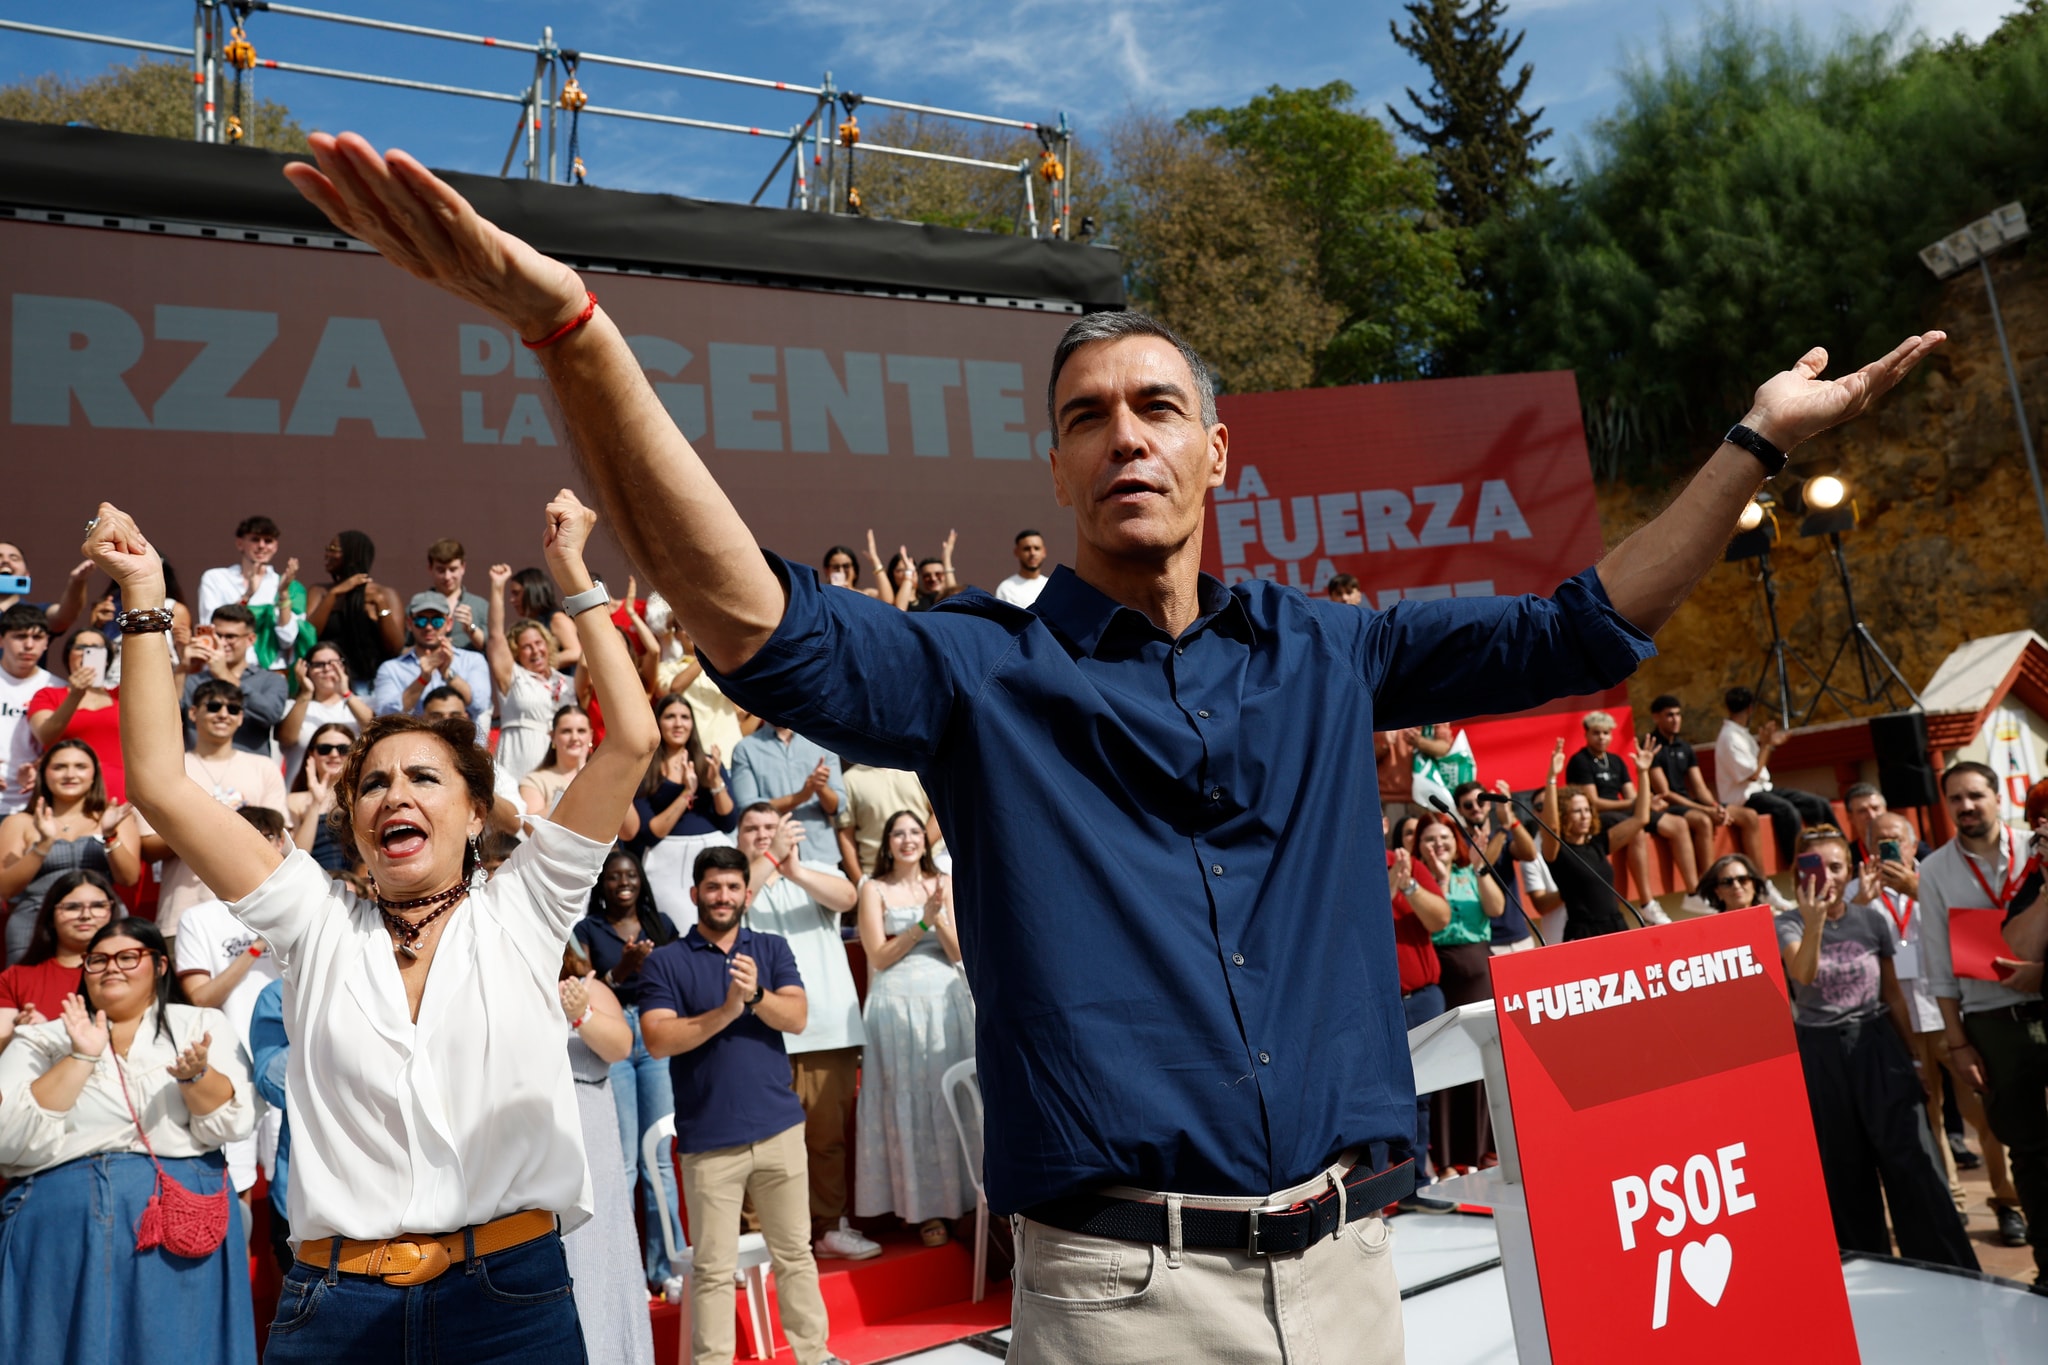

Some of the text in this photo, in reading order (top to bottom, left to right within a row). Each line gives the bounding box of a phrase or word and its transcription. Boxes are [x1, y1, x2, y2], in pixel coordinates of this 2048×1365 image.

[11, 293, 426, 439] RZA
[460, 391, 558, 446] LA
[1212, 464, 1270, 502] LA
[1214, 478, 1534, 566] FUERZA
[1503, 945, 1764, 1025] LA FUERZA DE LA GENTE.
[1611, 1141, 1757, 1251] PSOE
